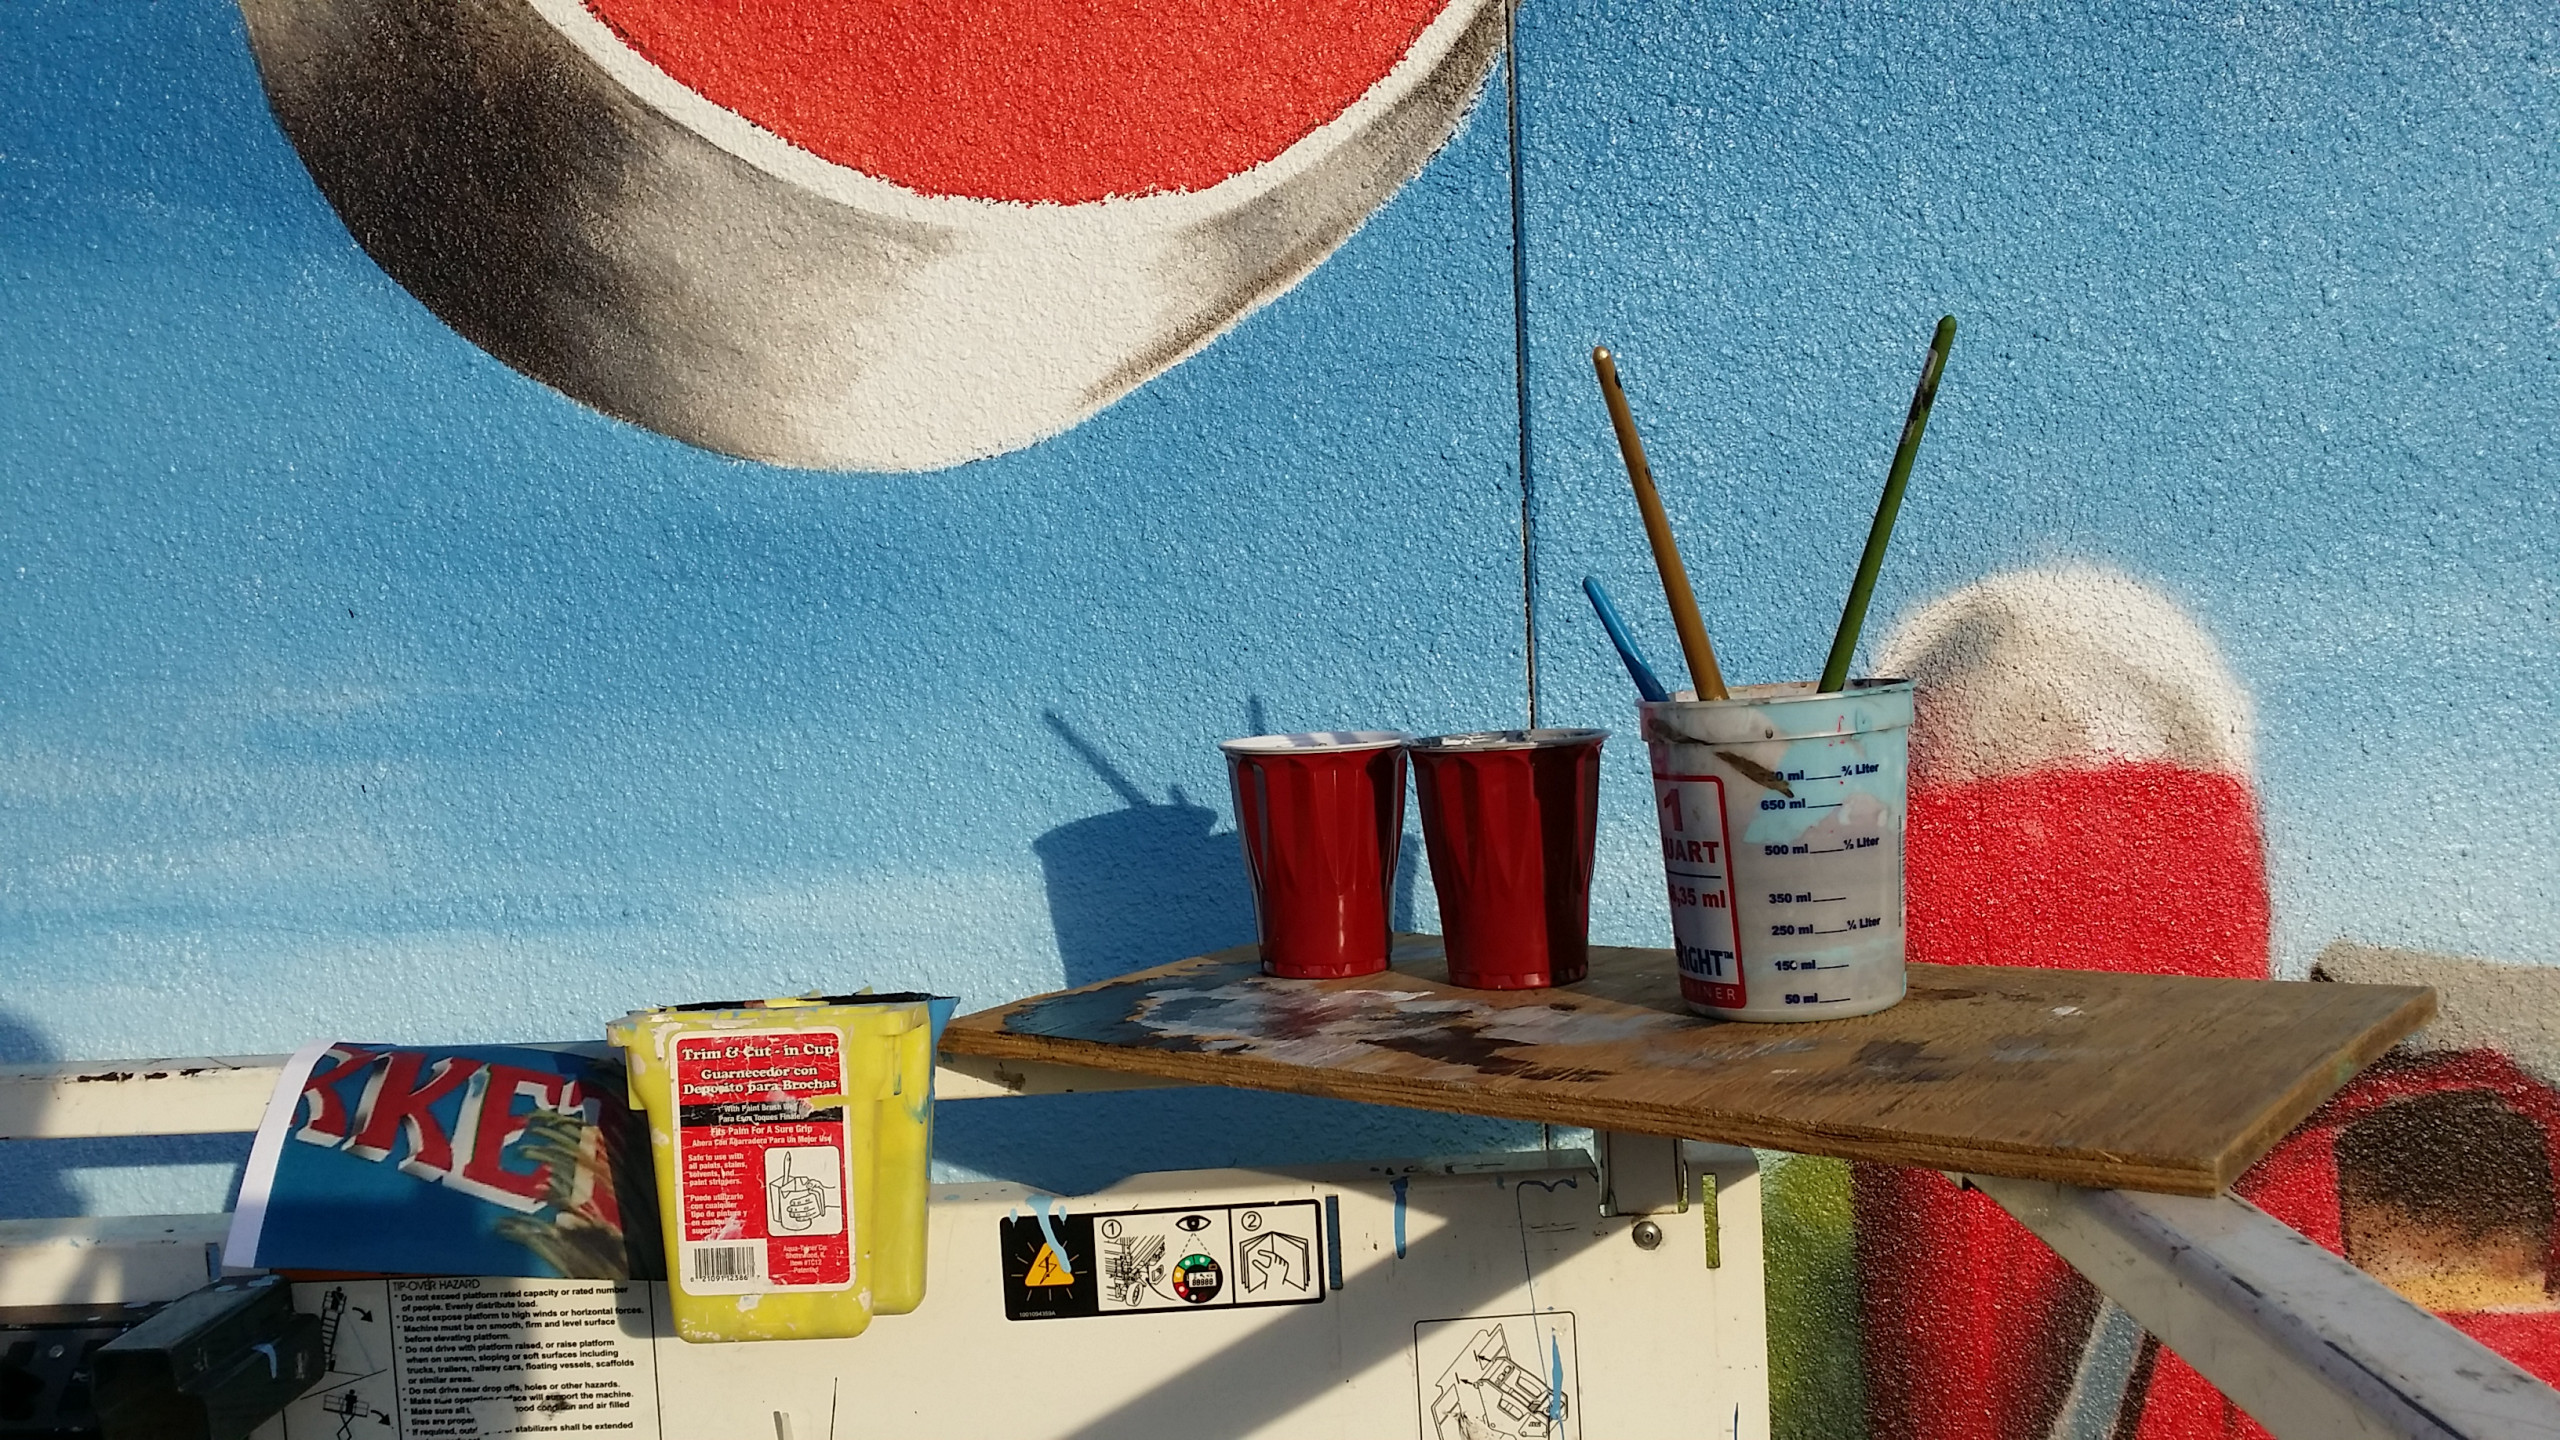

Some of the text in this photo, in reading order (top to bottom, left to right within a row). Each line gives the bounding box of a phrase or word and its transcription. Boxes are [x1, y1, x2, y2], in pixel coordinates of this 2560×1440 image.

[1788, 770, 1805, 781] ml
[1856, 763, 1880, 775] Liter
[1664, 788, 1683, 832] 1
[1760, 798, 1806, 811] 650 ml
[1664, 837, 1719, 864] UART
[1765, 845, 1789, 856] 500
[1792, 843, 1809, 854] ml
[1857, 837, 1880, 848] Liter
[1702, 890, 1726, 908] ml
[1769, 892, 1812, 904] 350 ml
[1772, 925, 1795, 936] 250
[1798, 924, 1814, 935] ml
[1860, 917, 1881, 929] Liter
[1801, 960, 1816, 970] ml
[1785, 993, 1818, 1004] 50 ml
[682, 1043, 834, 1060] Trim & Cut in Cup
[701, 1066, 818, 1080] Guarnecedor con
[747, 1081, 779, 1095] para
[783, 1078, 838, 1091] Brochas
[762, 1103, 782, 1111] Brush
[719, 1115, 734, 1123] Para
[754, 1114, 778, 1123] Toques
[728, 1124, 813, 1135] Palm For Sure Grip
[798, 1135, 818, 1144] Mejor
[393, 1279, 480, 1291] TIP-OVER HAZARD
[415, 1293, 429, 1301] not
[431, 1291, 461, 1300] exceed
[463, 1291, 498, 1300] platform
[500, 1290, 521, 1298] rated
[523, 1288, 559, 1298] capacity
[572, 1287, 594, 1295] rated
[596, 1286, 628, 1294] number
[402, 1300, 538, 1313] of people. Evenly distribute load.
[432, 1314, 462, 1323] expose
[464, 1311, 499, 1321] platform
[512, 1311, 531, 1320] high
[571, 1308, 614, 1316] horizontal
[615, 1307, 644, 1315] forces.
[403, 1325, 439, 1333] Machine
[489, 1321, 524, 1330] smooth,
[562, 1319, 582, 1327] level
[584, 1318, 615, 1326] surface
[404, 1332, 510, 1343] before elevating platform.
[419, 1345, 433, 1353] not
[435, 1344, 456, 1352] drive
[458, 1343, 476, 1351] with
[478, 1342, 513, 1351] platform
[515, 1341, 543, 1350] raised,
[557, 1340, 577, 1348] raise
[579, 1339, 614, 1348] platform
[443, 1355, 476, 1363] uneven,
[479, 1353, 510, 1362] sloping
[523, 1352, 539, 1360] soft
[541, 1351, 577, 1359] surfaces
[580, 1350, 619, 1358] including
[407, 1366, 436, 1374] trucks,
[438, 1365, 469, 1373] trailers,
[471, 1364, 501, 1373] railway
[525, 1362, 558, 1371] floating
[560, 1361, 594, 1369] vessels,
[596, 1359, 634, 1368] scaffolds
[419, 1376, 447, 1384] similar
[423, 1386, 437, 1394] not
[439, 1385, 459, 1394] drive
[482, 1384, 502, 1393] drop
[504, 1383, 523, 1392] offs,
[524, 1383, 547, 1391] holes
[585, 1380, 620, 1389] hazards.
[410, 1397, 435, 1405] Make
[529, 1393, 544, 1401] will
[580, 1391, 594, 1399] the
[596, 1390, 634, 1399] machine.
[578, 1402, 594, 1410] and
[609, 1401, 629, 1409] filled
[420, 1428, 457, 1437] required,
[515, 1424, 558, 1433] stabilizers
[560, 1423, 580, 1431] shall
[595, 1421, 633, 1430] extended
